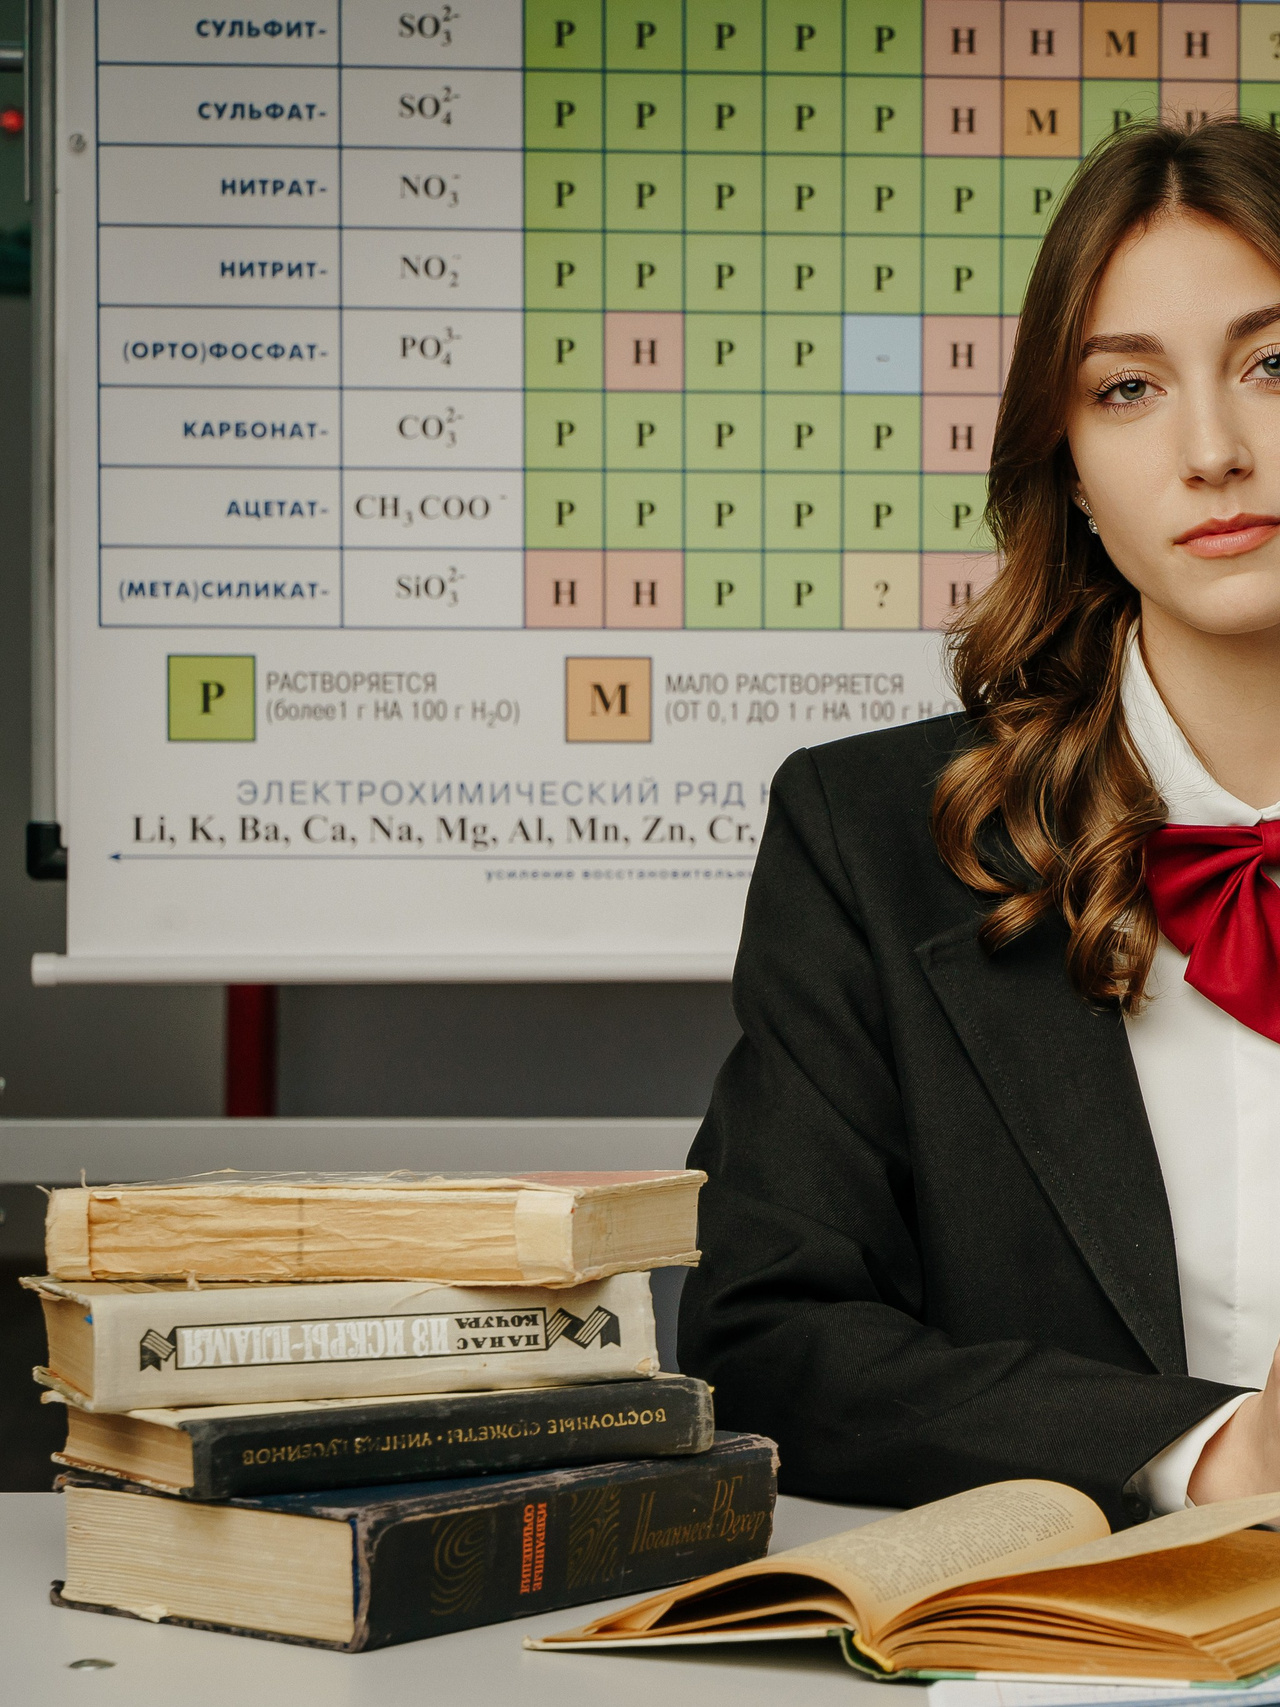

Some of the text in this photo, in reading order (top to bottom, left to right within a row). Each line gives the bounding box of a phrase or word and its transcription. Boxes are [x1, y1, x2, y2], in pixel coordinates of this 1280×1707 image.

[195, 18, 327, 39] СУЛЬФИТ-
[196, 101, 327, 121] СУЛЬФАТ-
[220, 178, 327, 197] НИТРАТ-
[219, 260, 326, 279] НИТРИТ-
[122, 340, 327, 364] (ОРТО)ФОСФАТ-
[182, 420, 327, 440] КАРБОНАТ-
[225, 499, 327, 520] АЦЕТАТ-
[118, 580, 328, 602] (МЕТА)СИЛИКАТ-
[265, 670, 437, 695] РАСТВОРЯЕТСЯ
[665, 672, 905, 696] МАЛО РАСТВОРЯЕТСЯ
[356, 703, 367, 721] г
[373, 699, 403, 721] НА
[411, 698, 449, 722] 100
[453, 703, 465, 722] г
[591, 682, 629, 716] М
[745, 699, 780, 725] ДО
[788, 700, 797, 722] 1
[822, 700, 852, 722] НА
[858, 702, 896, 724] 100
[236, 777, 659, 807] ЭЛЕКТРОХИМИЧЕСКИЙ
[674, 780, 747, 810] РЯД
[133, 815, 757, 850] Li, K, Ba, Ca, Na, Mg, Al, Mn, Zn, Cr,
[455, 1313, 541, 1330] КОЧУРА
[181, 1317, 451, 1368] ИЗ ИСКРЫ-ПЛАМЯ
[456, 1334, 541, 1350] ПАНАС
[547, 1407, 667, 1430] ВОСТОЧНЫЕ
[446, 1418, 541, 1444] СЮЖЕТЫ
[520, 1504, 535, 1594] СОЧИНЕНИЯ
[532, 1502, 548, 1592] ИЗБРАННЫЕ
